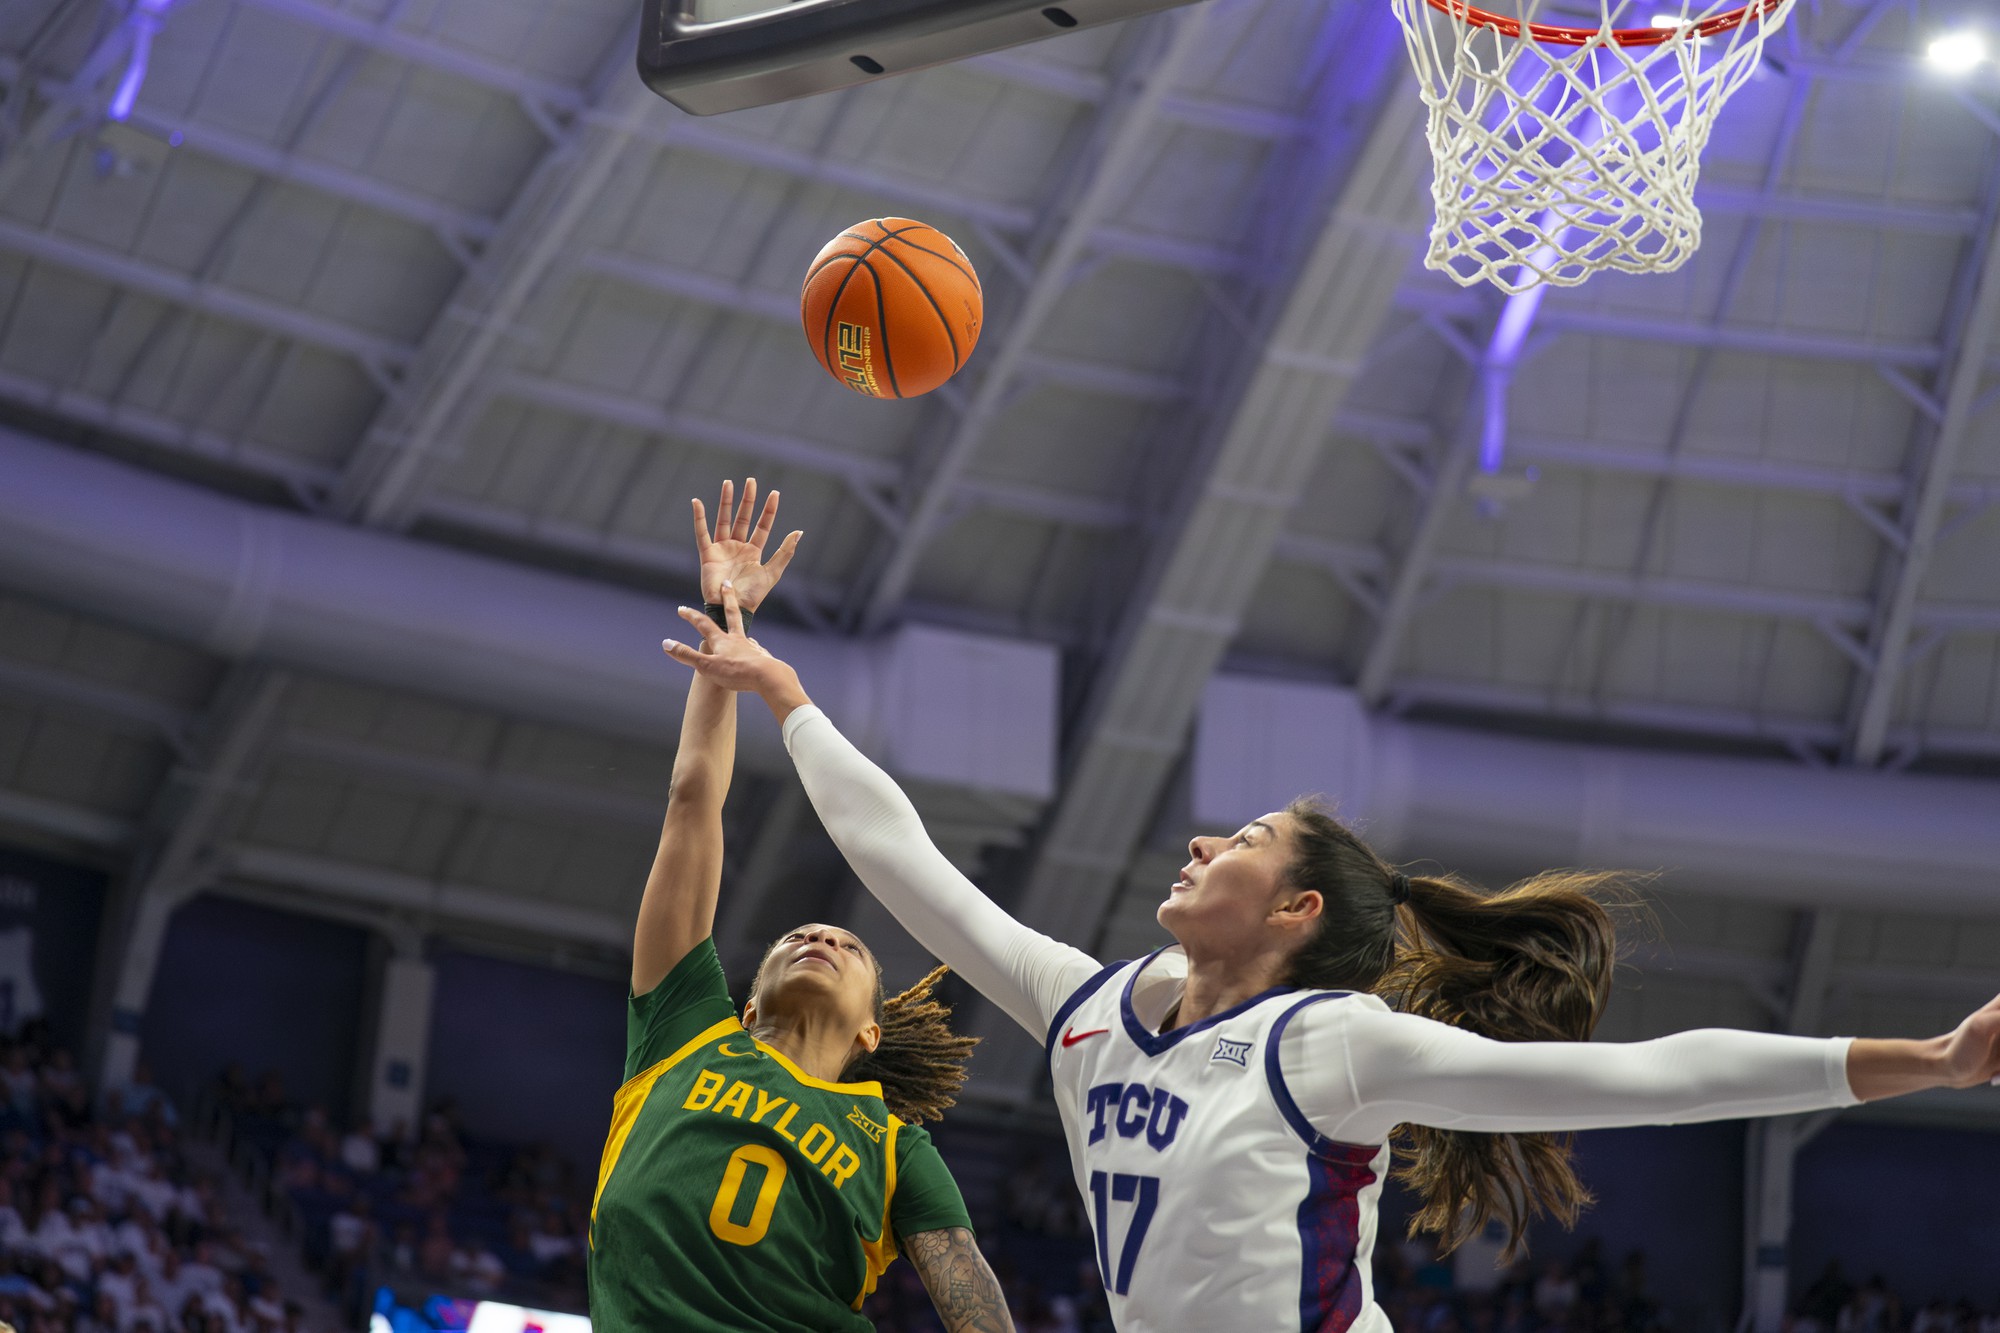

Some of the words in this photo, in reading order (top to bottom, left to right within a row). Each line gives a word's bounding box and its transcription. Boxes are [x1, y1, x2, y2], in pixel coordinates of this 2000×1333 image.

[837, 320, 874, 396] ELITE
[682, 1068, 861, 1189] BAYLOR
[1086, 1082, 1189, 1152] TCU
[709, 1143, 787, 1246] 0
[1089, 1170, 1160, 1296] 17
